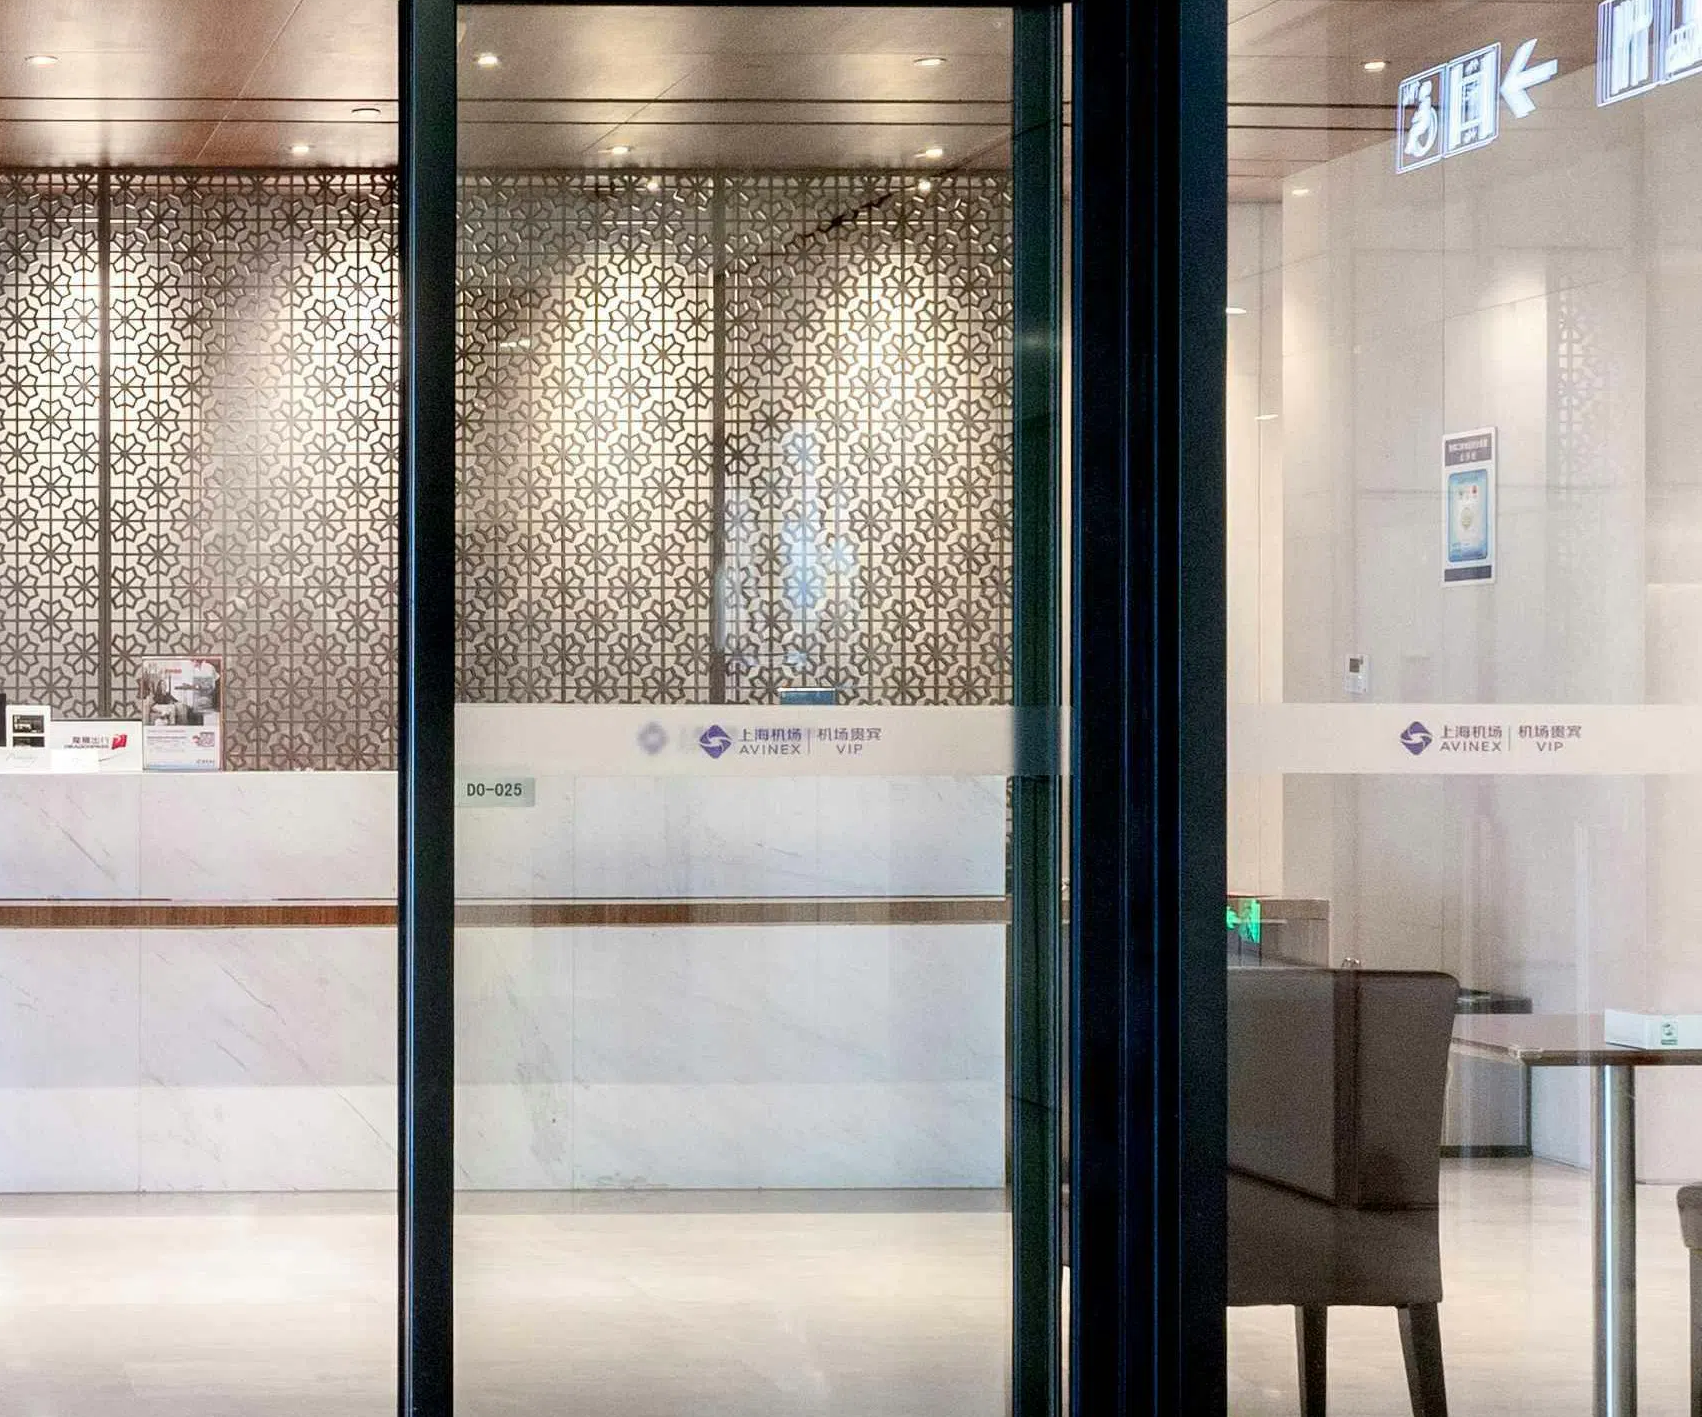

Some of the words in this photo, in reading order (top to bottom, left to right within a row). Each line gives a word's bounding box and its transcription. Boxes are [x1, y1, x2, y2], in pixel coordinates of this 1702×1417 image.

[738, 727, 802, 742] 上海机场
[817, 727, 882, 742] 机场贵宾
[1440, 725, 1502, 739] 上海机场
[739, 743, 801, 755] AVINEX
[836, 743, 863, 755] VIP
[1439, 741, 1502, 752] AVINEX
[1536, 741, 1564, 752] VIP
